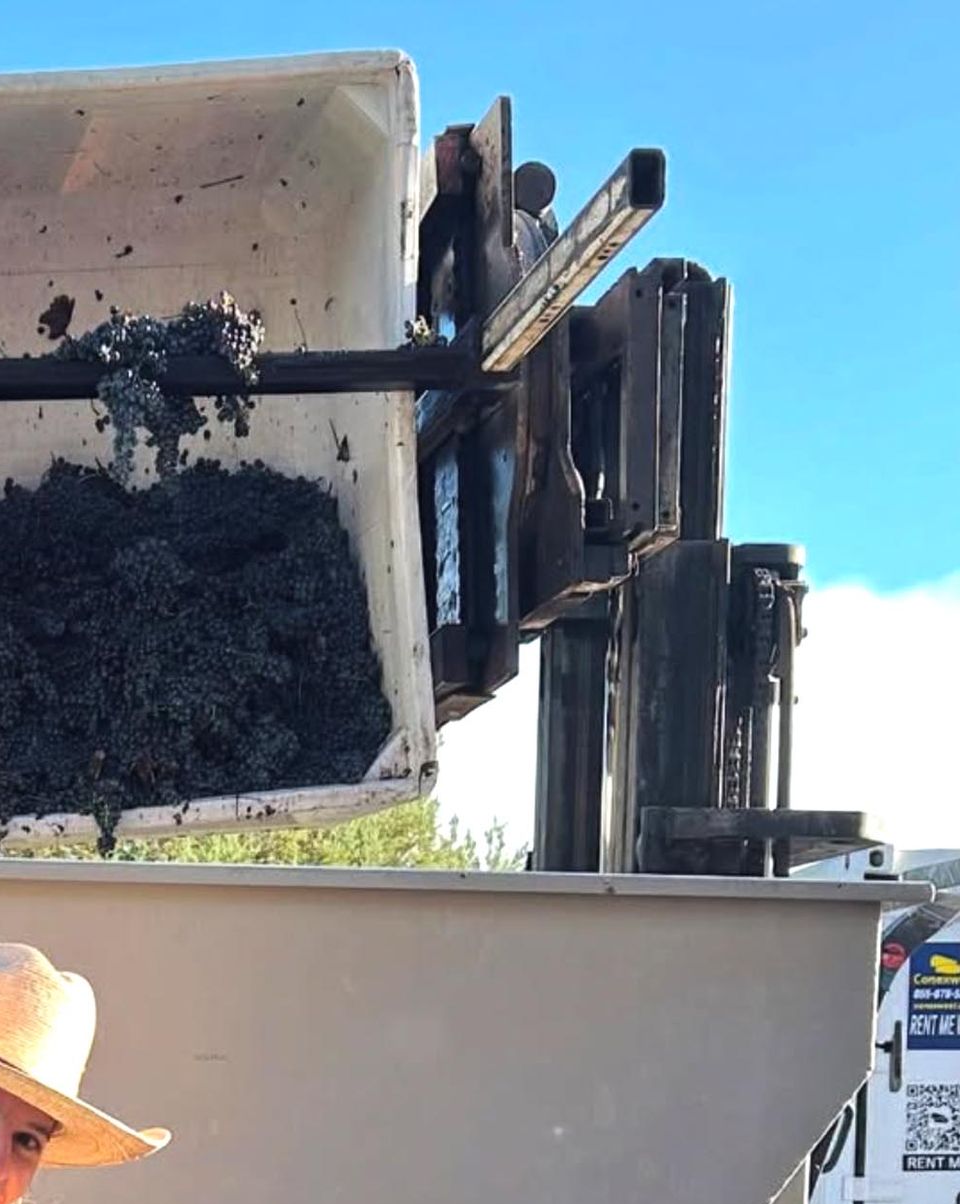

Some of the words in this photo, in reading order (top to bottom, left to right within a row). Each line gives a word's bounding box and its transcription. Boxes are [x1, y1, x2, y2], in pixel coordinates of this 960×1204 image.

[910, 1014, 938, 1035] RENT
[939, 1014, 955, 1035] ME
[907, 1157, 944, 1169] RENT
